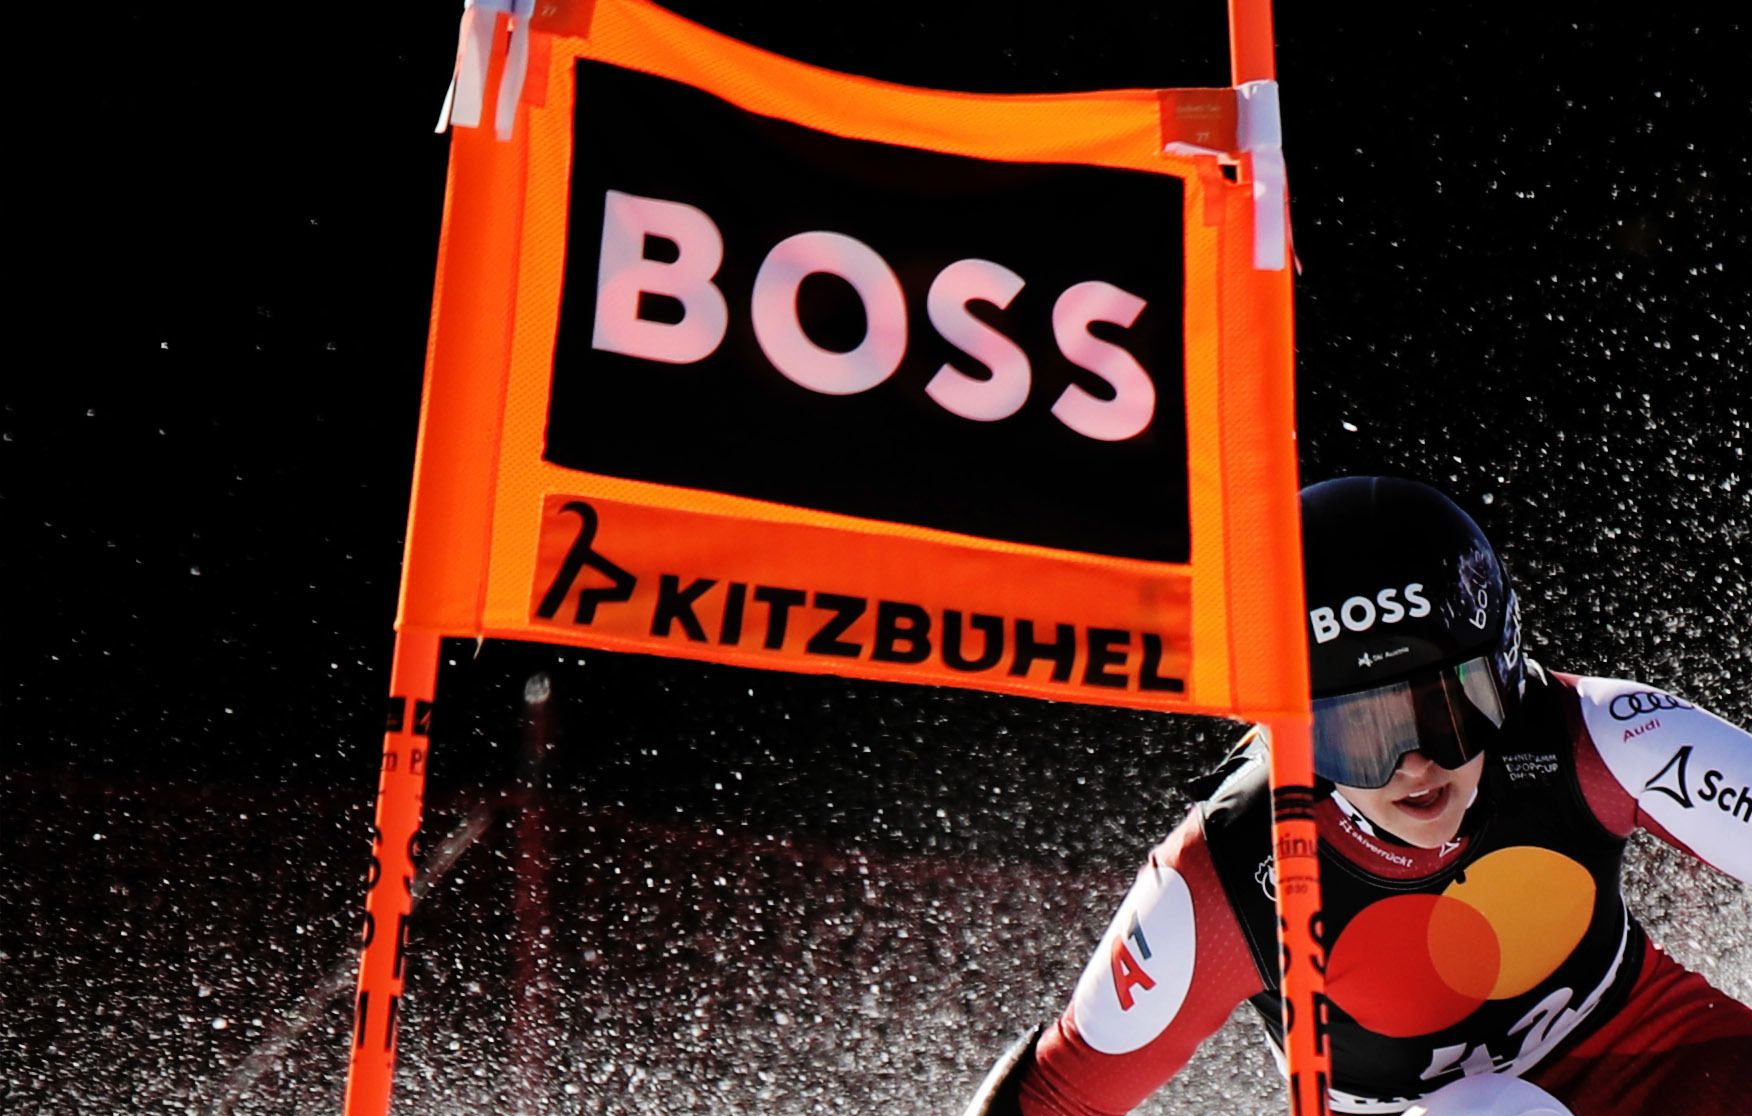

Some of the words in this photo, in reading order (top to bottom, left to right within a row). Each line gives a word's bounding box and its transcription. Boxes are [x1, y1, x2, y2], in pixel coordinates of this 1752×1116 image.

[592, 189, 1156, 441] BOSS
[1310, 582, 1432, 644] BOSS
[1623, 717, 1662, 743] Audi
[1110, 909, 1157, 1012] A1
